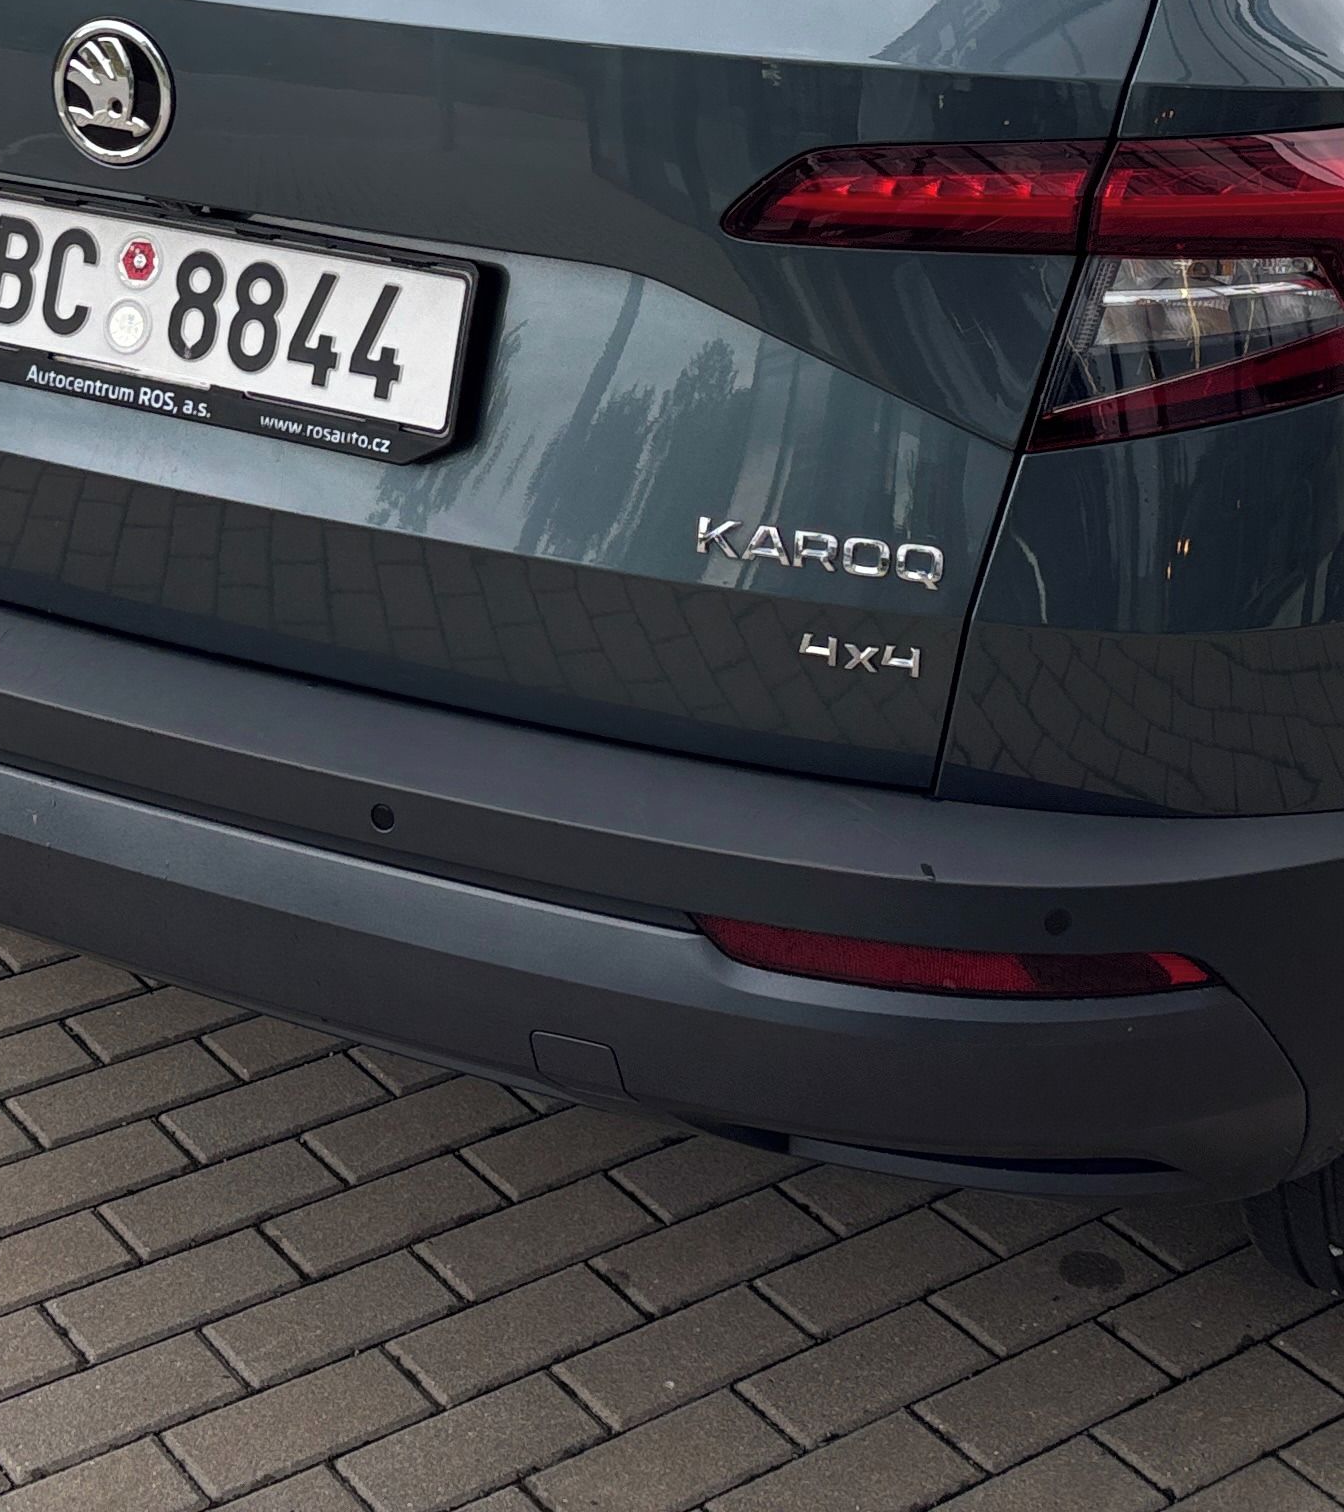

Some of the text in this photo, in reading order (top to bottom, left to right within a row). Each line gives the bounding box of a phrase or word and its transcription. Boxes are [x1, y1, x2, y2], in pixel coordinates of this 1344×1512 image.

[168, 250, 403, 400] 8844
[25, 364, 211, 419] Autocentrum ROS, a.s.
[260, 414, 392, 454] www.rosauto.cz
[696, 516, 944, 590] KAROQ
[798, 633, 921, 678] 4x4
